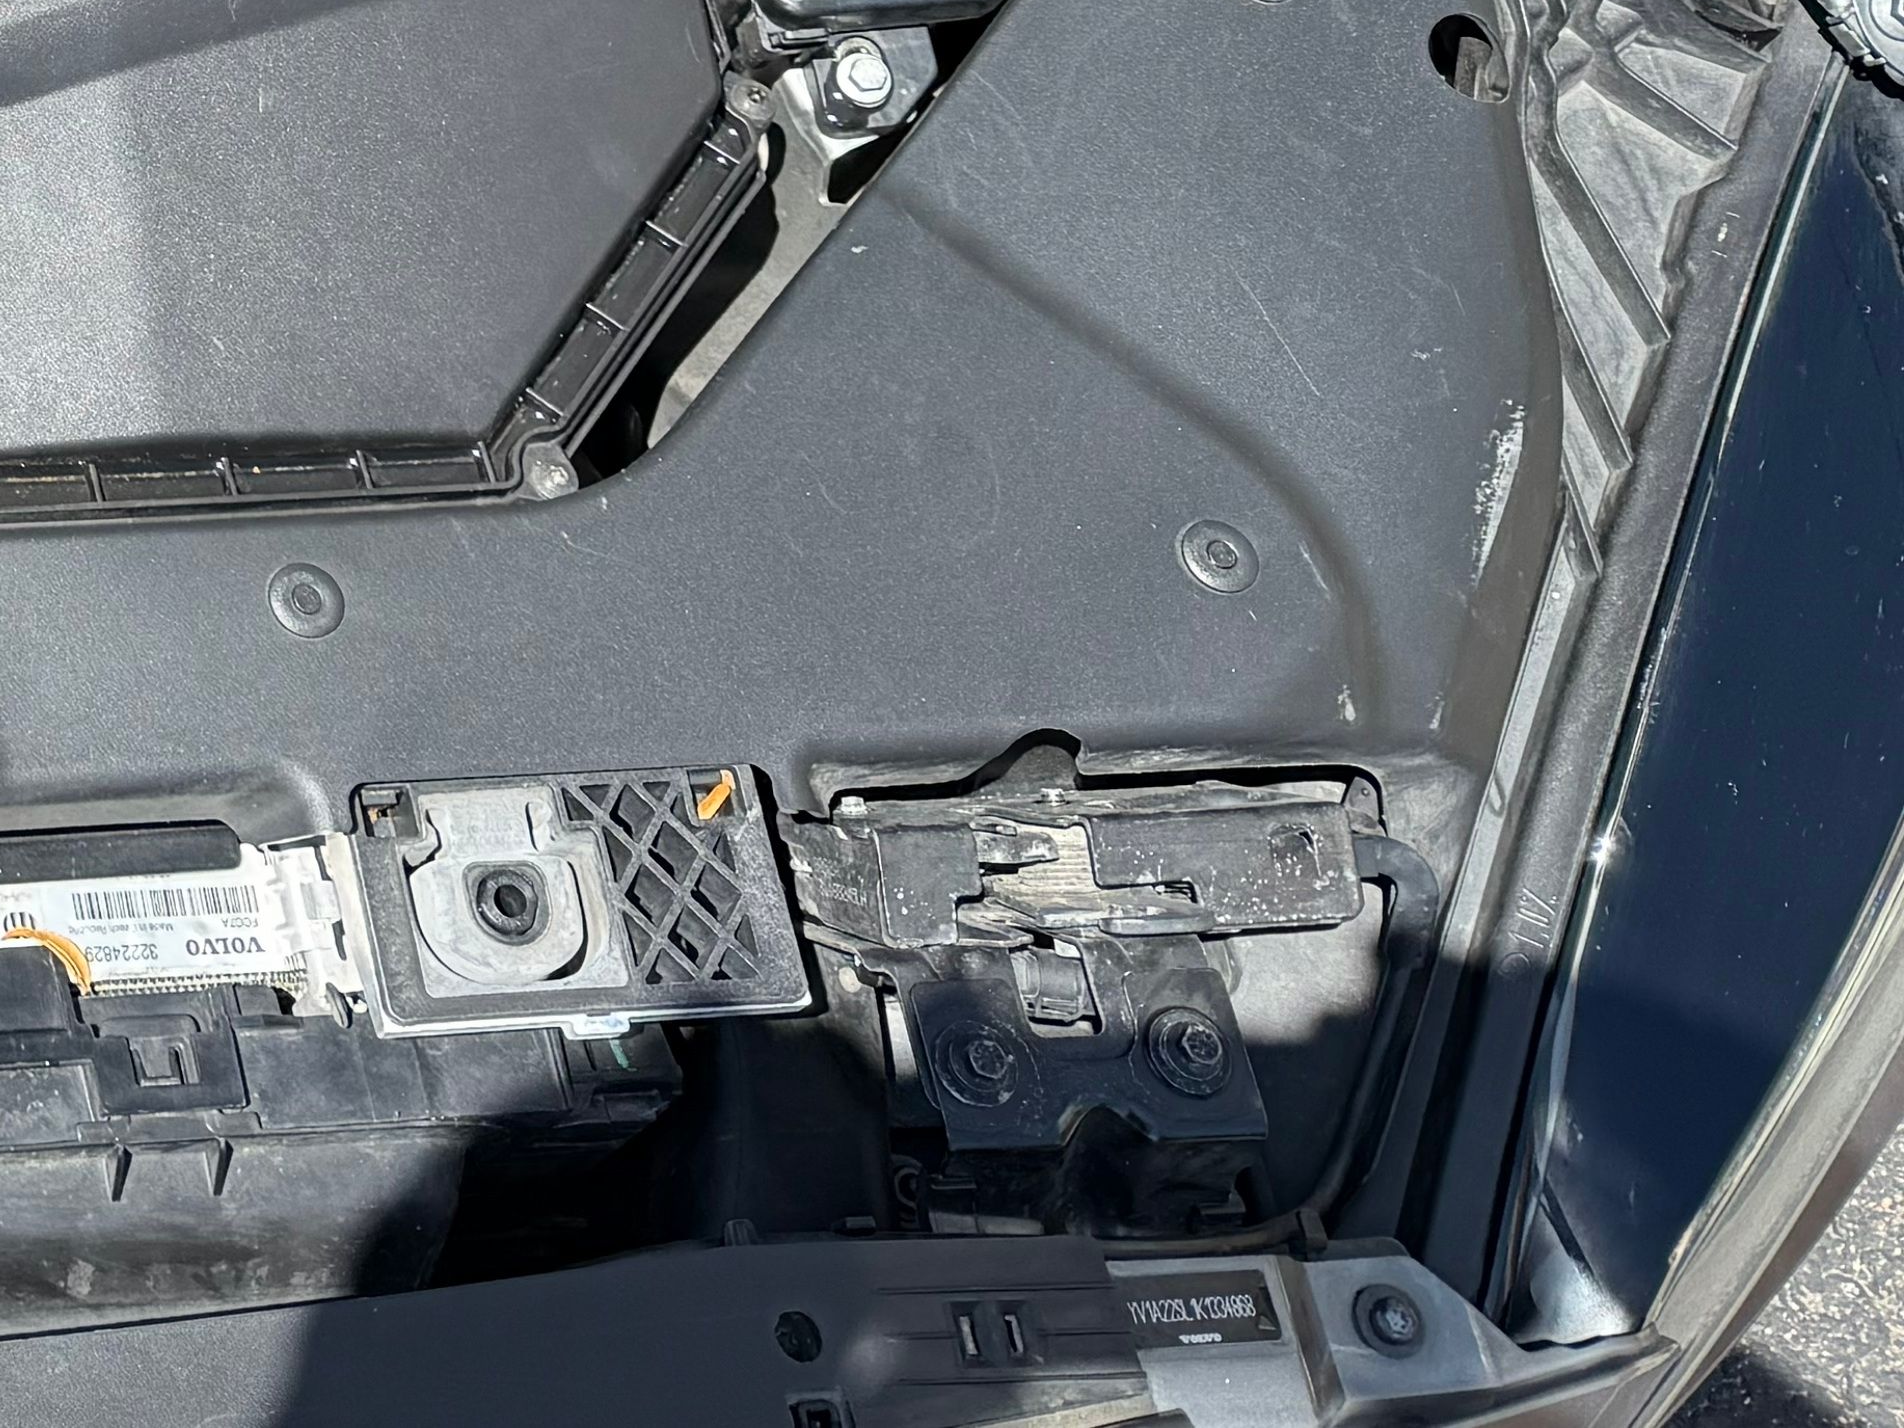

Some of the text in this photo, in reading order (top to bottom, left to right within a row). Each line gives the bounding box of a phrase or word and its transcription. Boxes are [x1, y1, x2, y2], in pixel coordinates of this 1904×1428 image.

[85, 936, 266, 962] VOLVO 32224829
[1178, 1331, 1223, 1344] VOLVO
